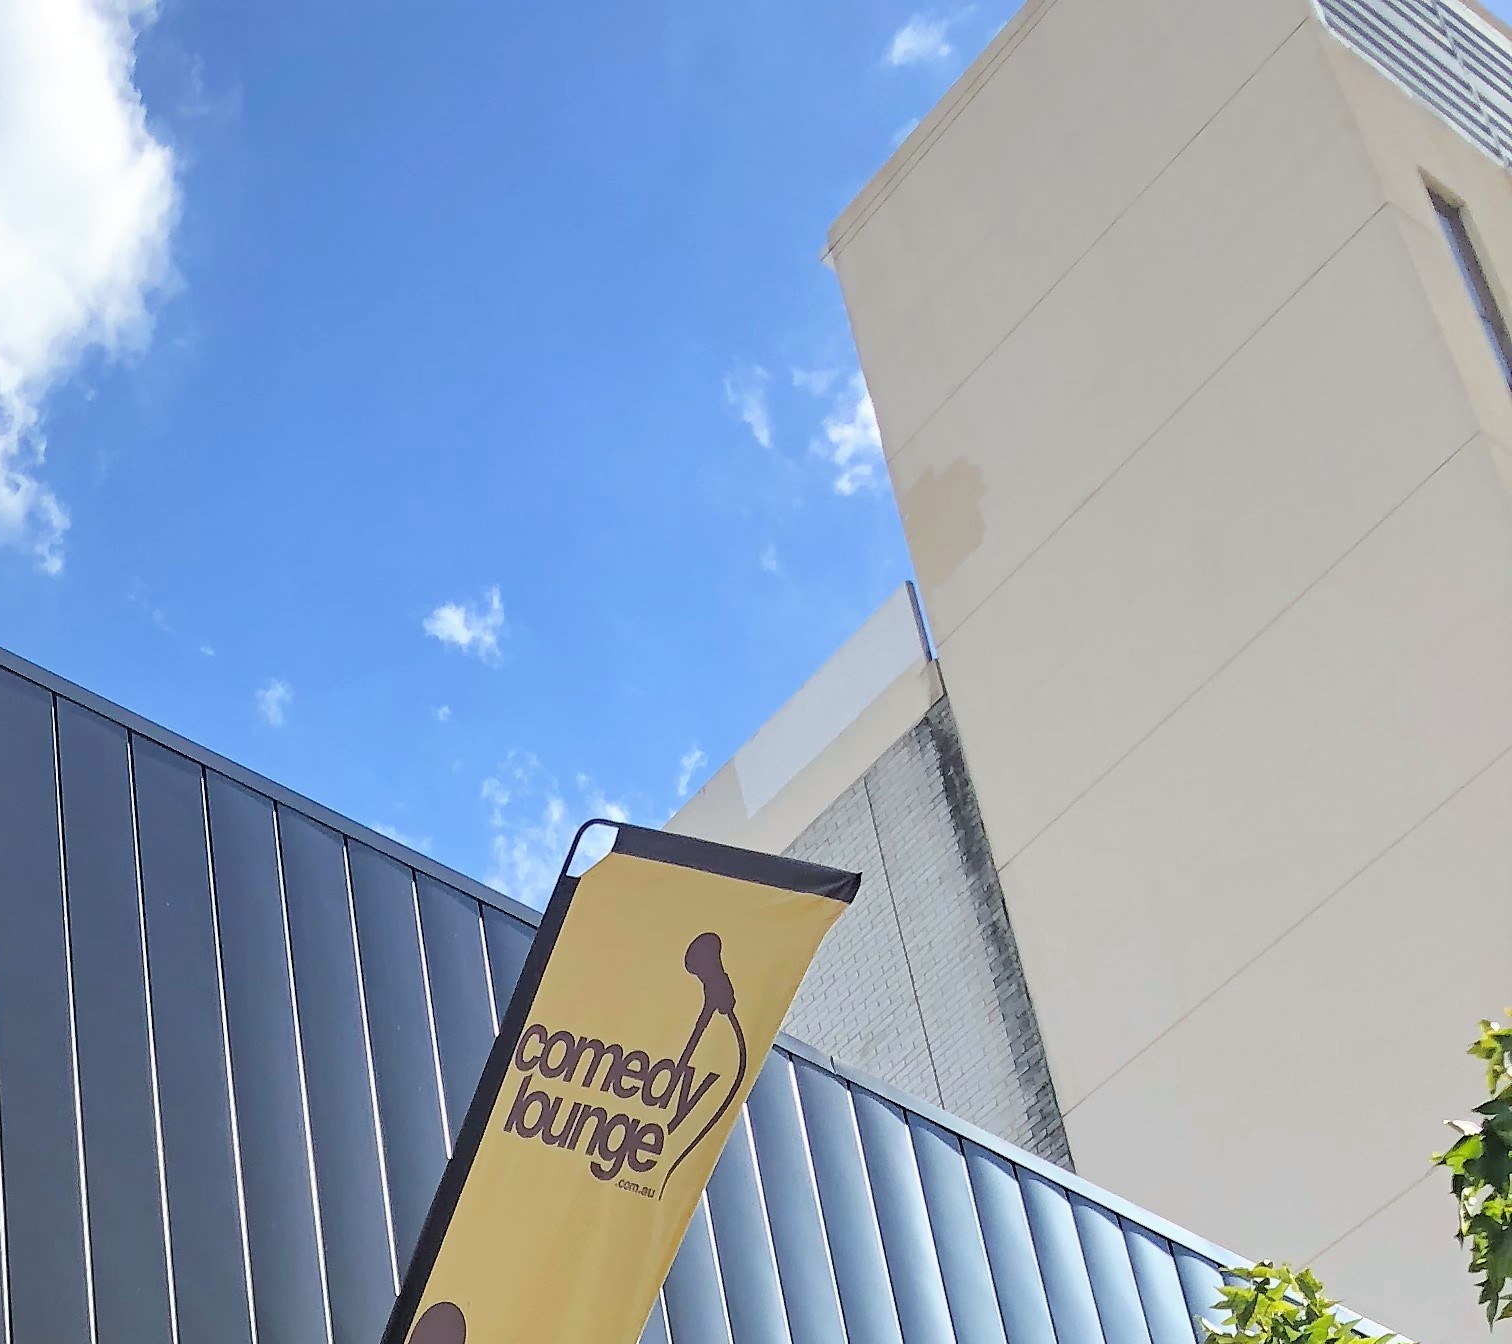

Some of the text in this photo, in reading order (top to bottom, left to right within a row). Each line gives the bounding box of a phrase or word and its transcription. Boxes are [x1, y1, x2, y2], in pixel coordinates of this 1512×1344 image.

[504, 1075, 666, 1181] lounge
[515, 1024, 721, 1135] comedy
[615, 1178, 656, 1199] .com.au
